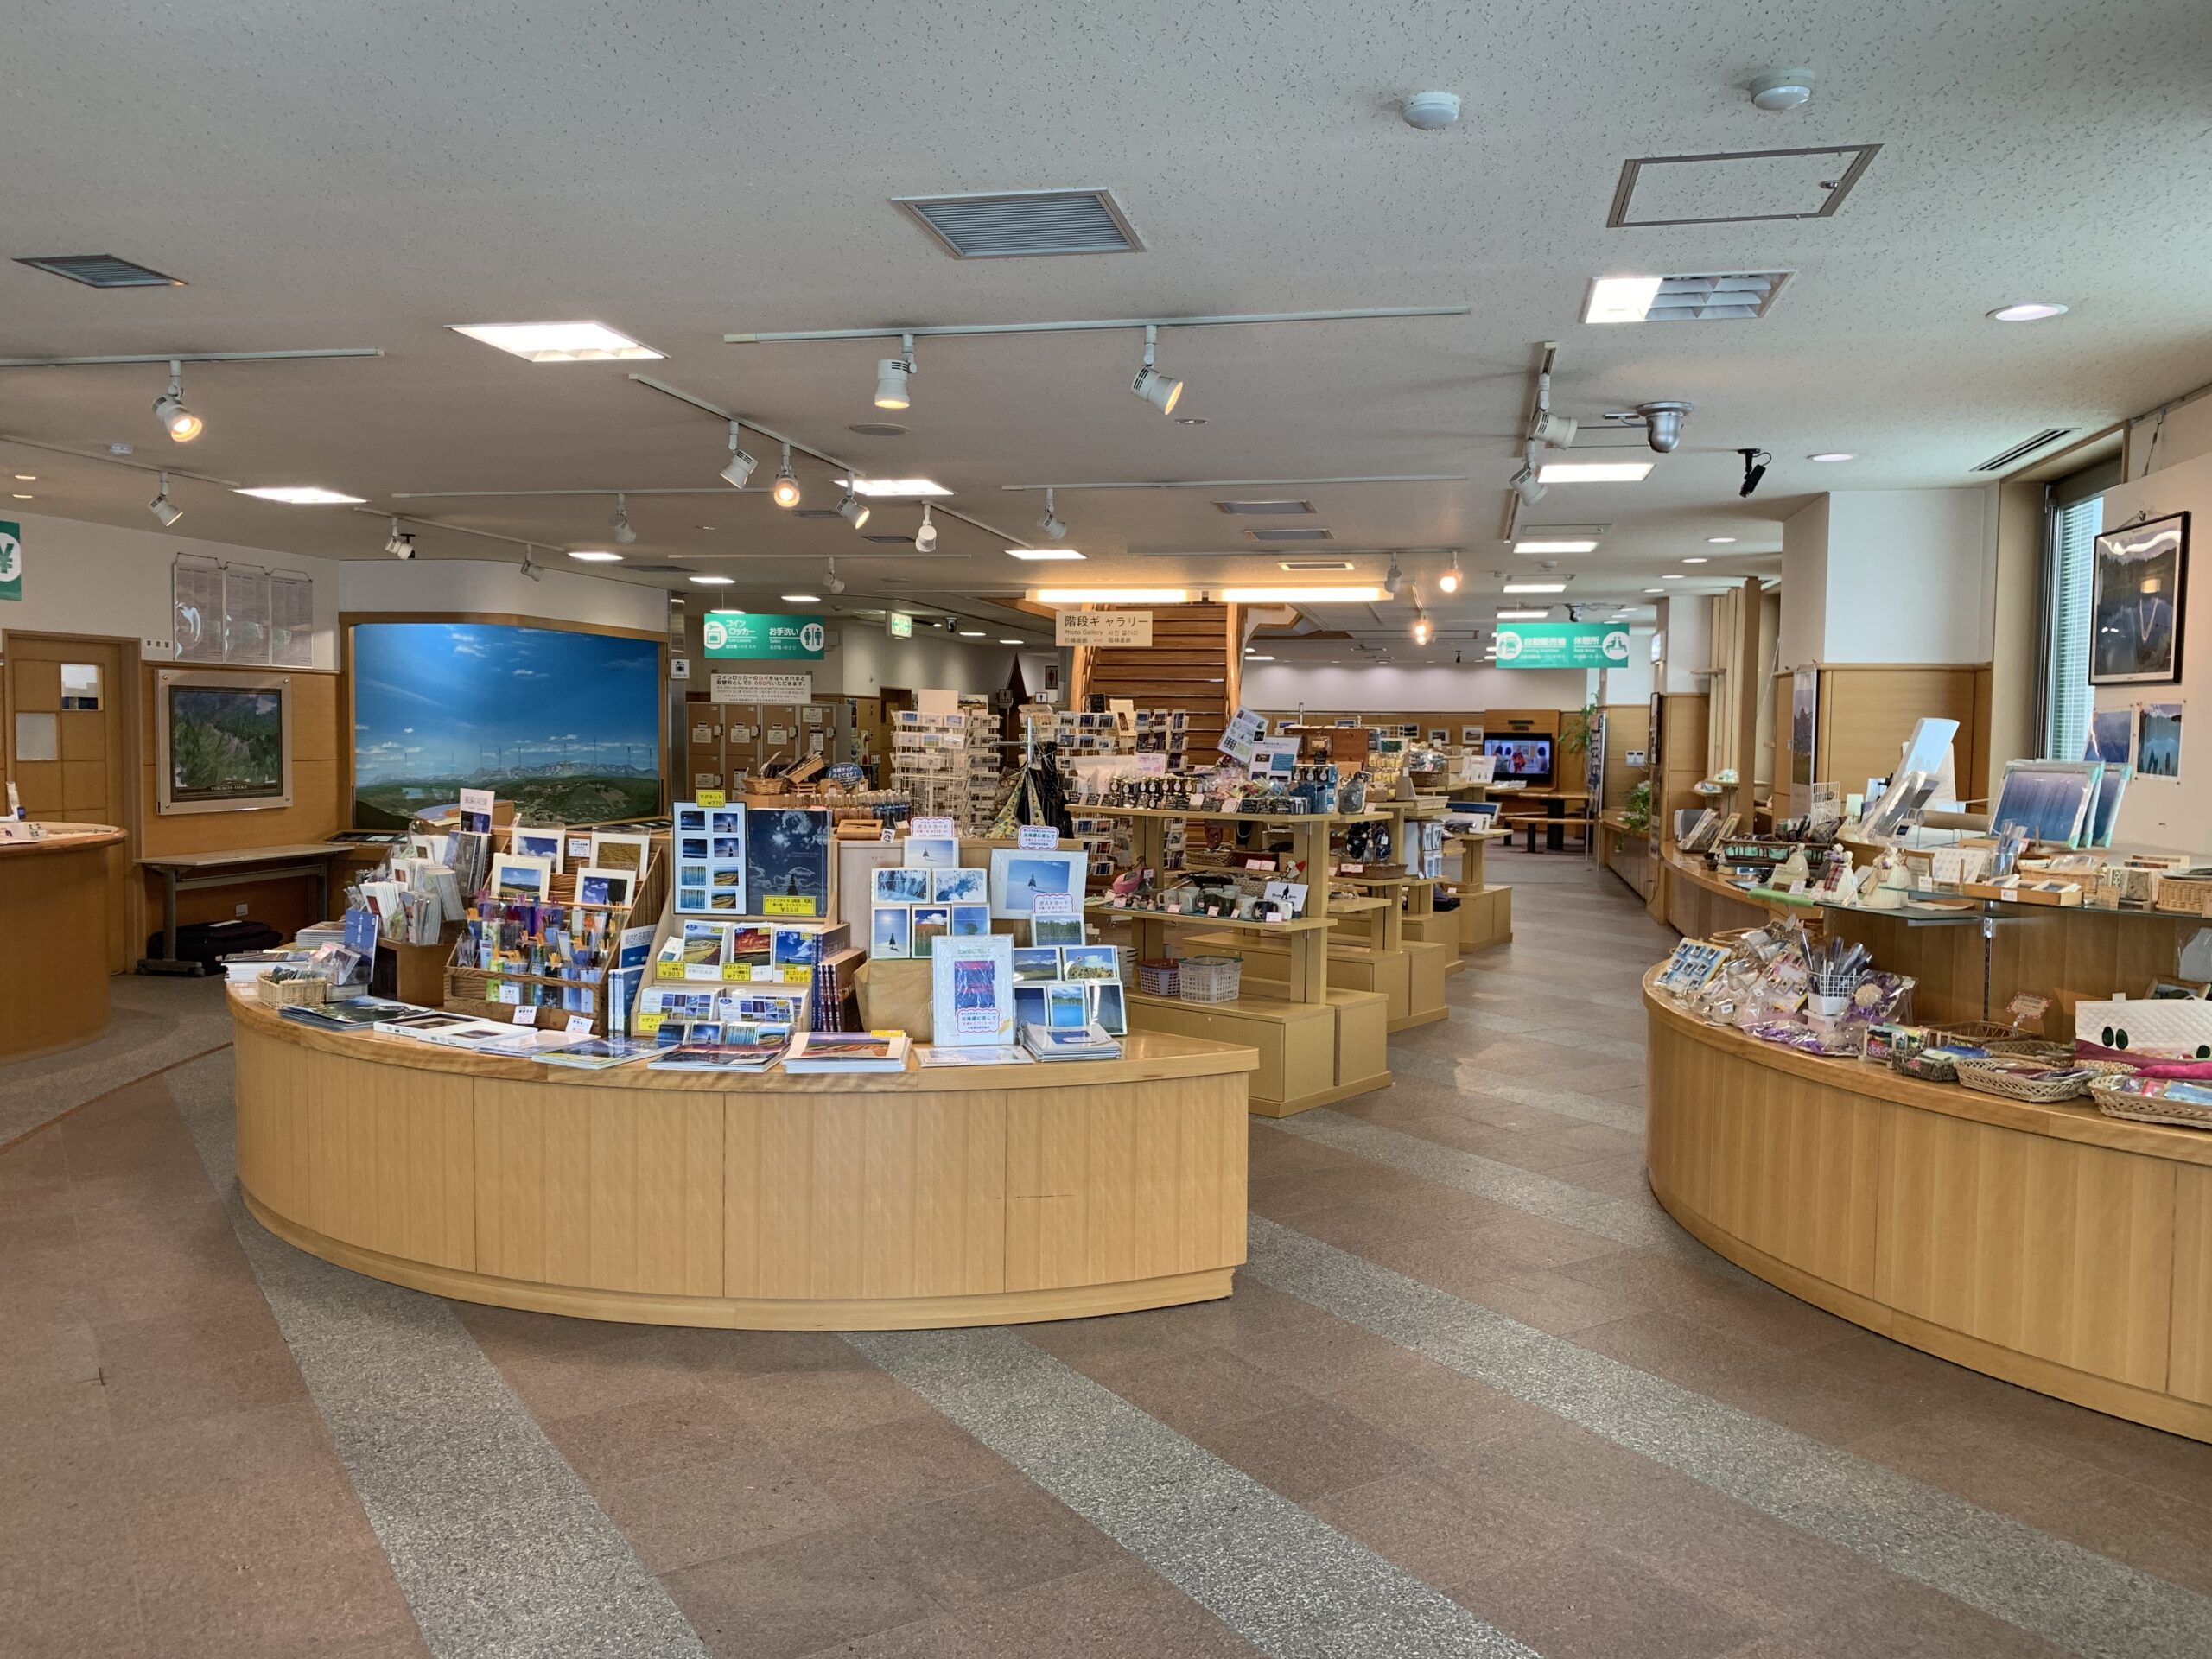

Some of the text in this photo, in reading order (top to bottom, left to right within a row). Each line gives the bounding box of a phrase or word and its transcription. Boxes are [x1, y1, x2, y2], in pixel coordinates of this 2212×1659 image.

[726, 620, 746, 628] コイン
[1065, 615, 1148, 627] 階段ギャラリー
[728, 627, 756, 636] ロッカー
[769, 627, 798, 636] お手洗い
[1573, 636, 1599, 645] 休憩所
